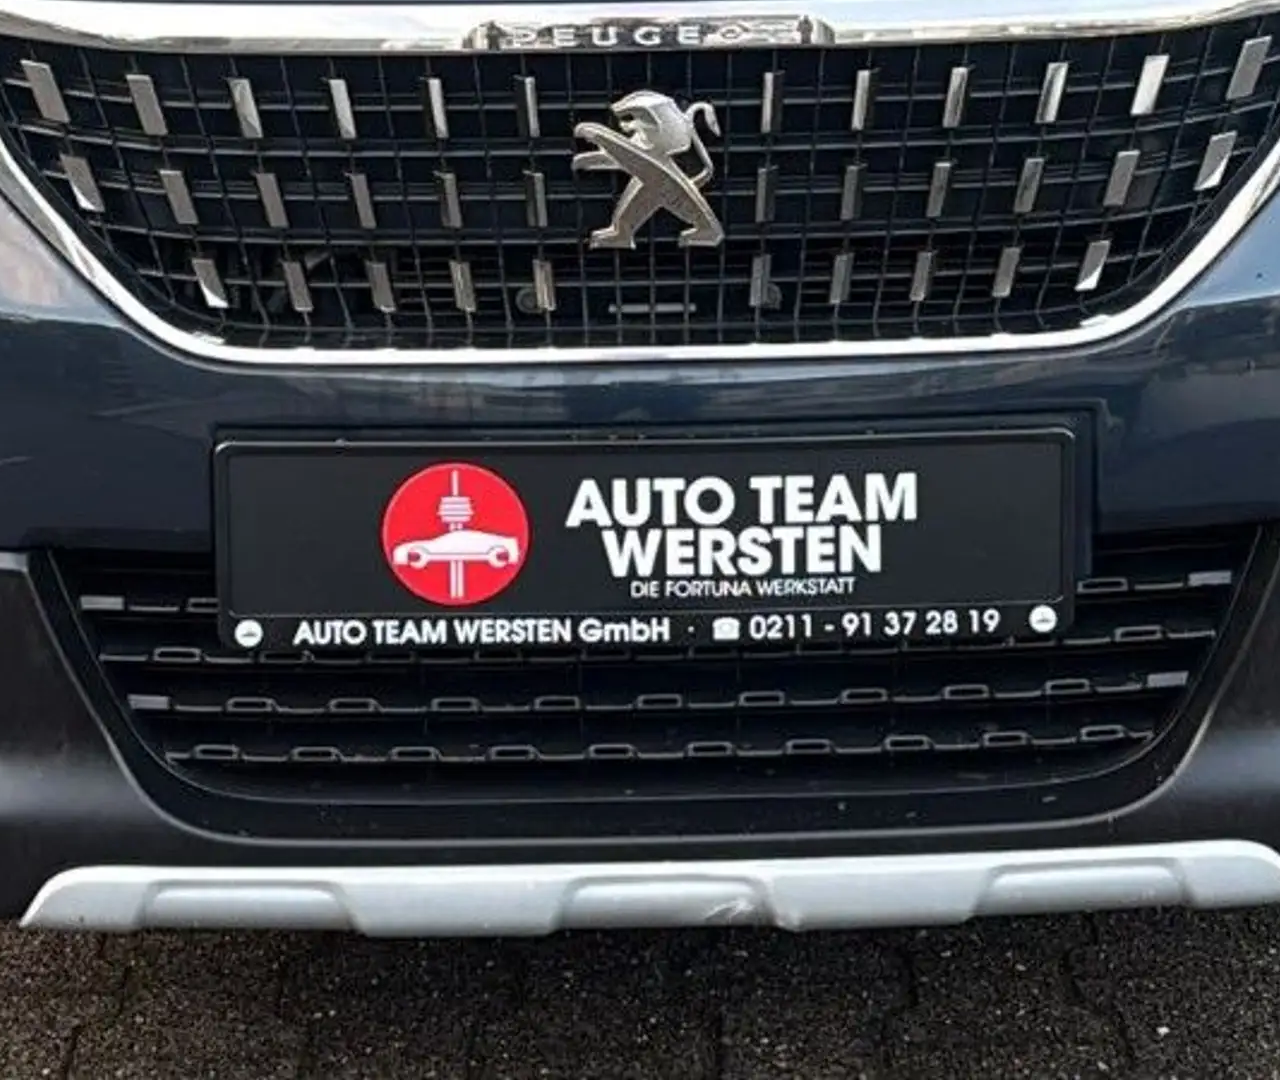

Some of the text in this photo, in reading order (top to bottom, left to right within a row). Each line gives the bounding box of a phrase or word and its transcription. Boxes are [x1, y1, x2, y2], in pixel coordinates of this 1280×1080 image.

[565, 472, 917, 528] AUTO TEAM
[601, 525, 882, 578] WERSTEN
[630, 577, 856, 598] DIE FORTUNA WERKSTATT
[292, 620, 367, 646] AUTO
[372, 619, 448, 645] TEAM
[453, 618, 572, 644] WERSTEN
[578, 617, 671, 644] GmbH
[748, 615, 813, 640] 0211
[841, 612, 872, 637] 91
[883, 611, 918, 636] 37
[925, 609, 959, 635] 28
[967, 608, 1002, 634] 19
